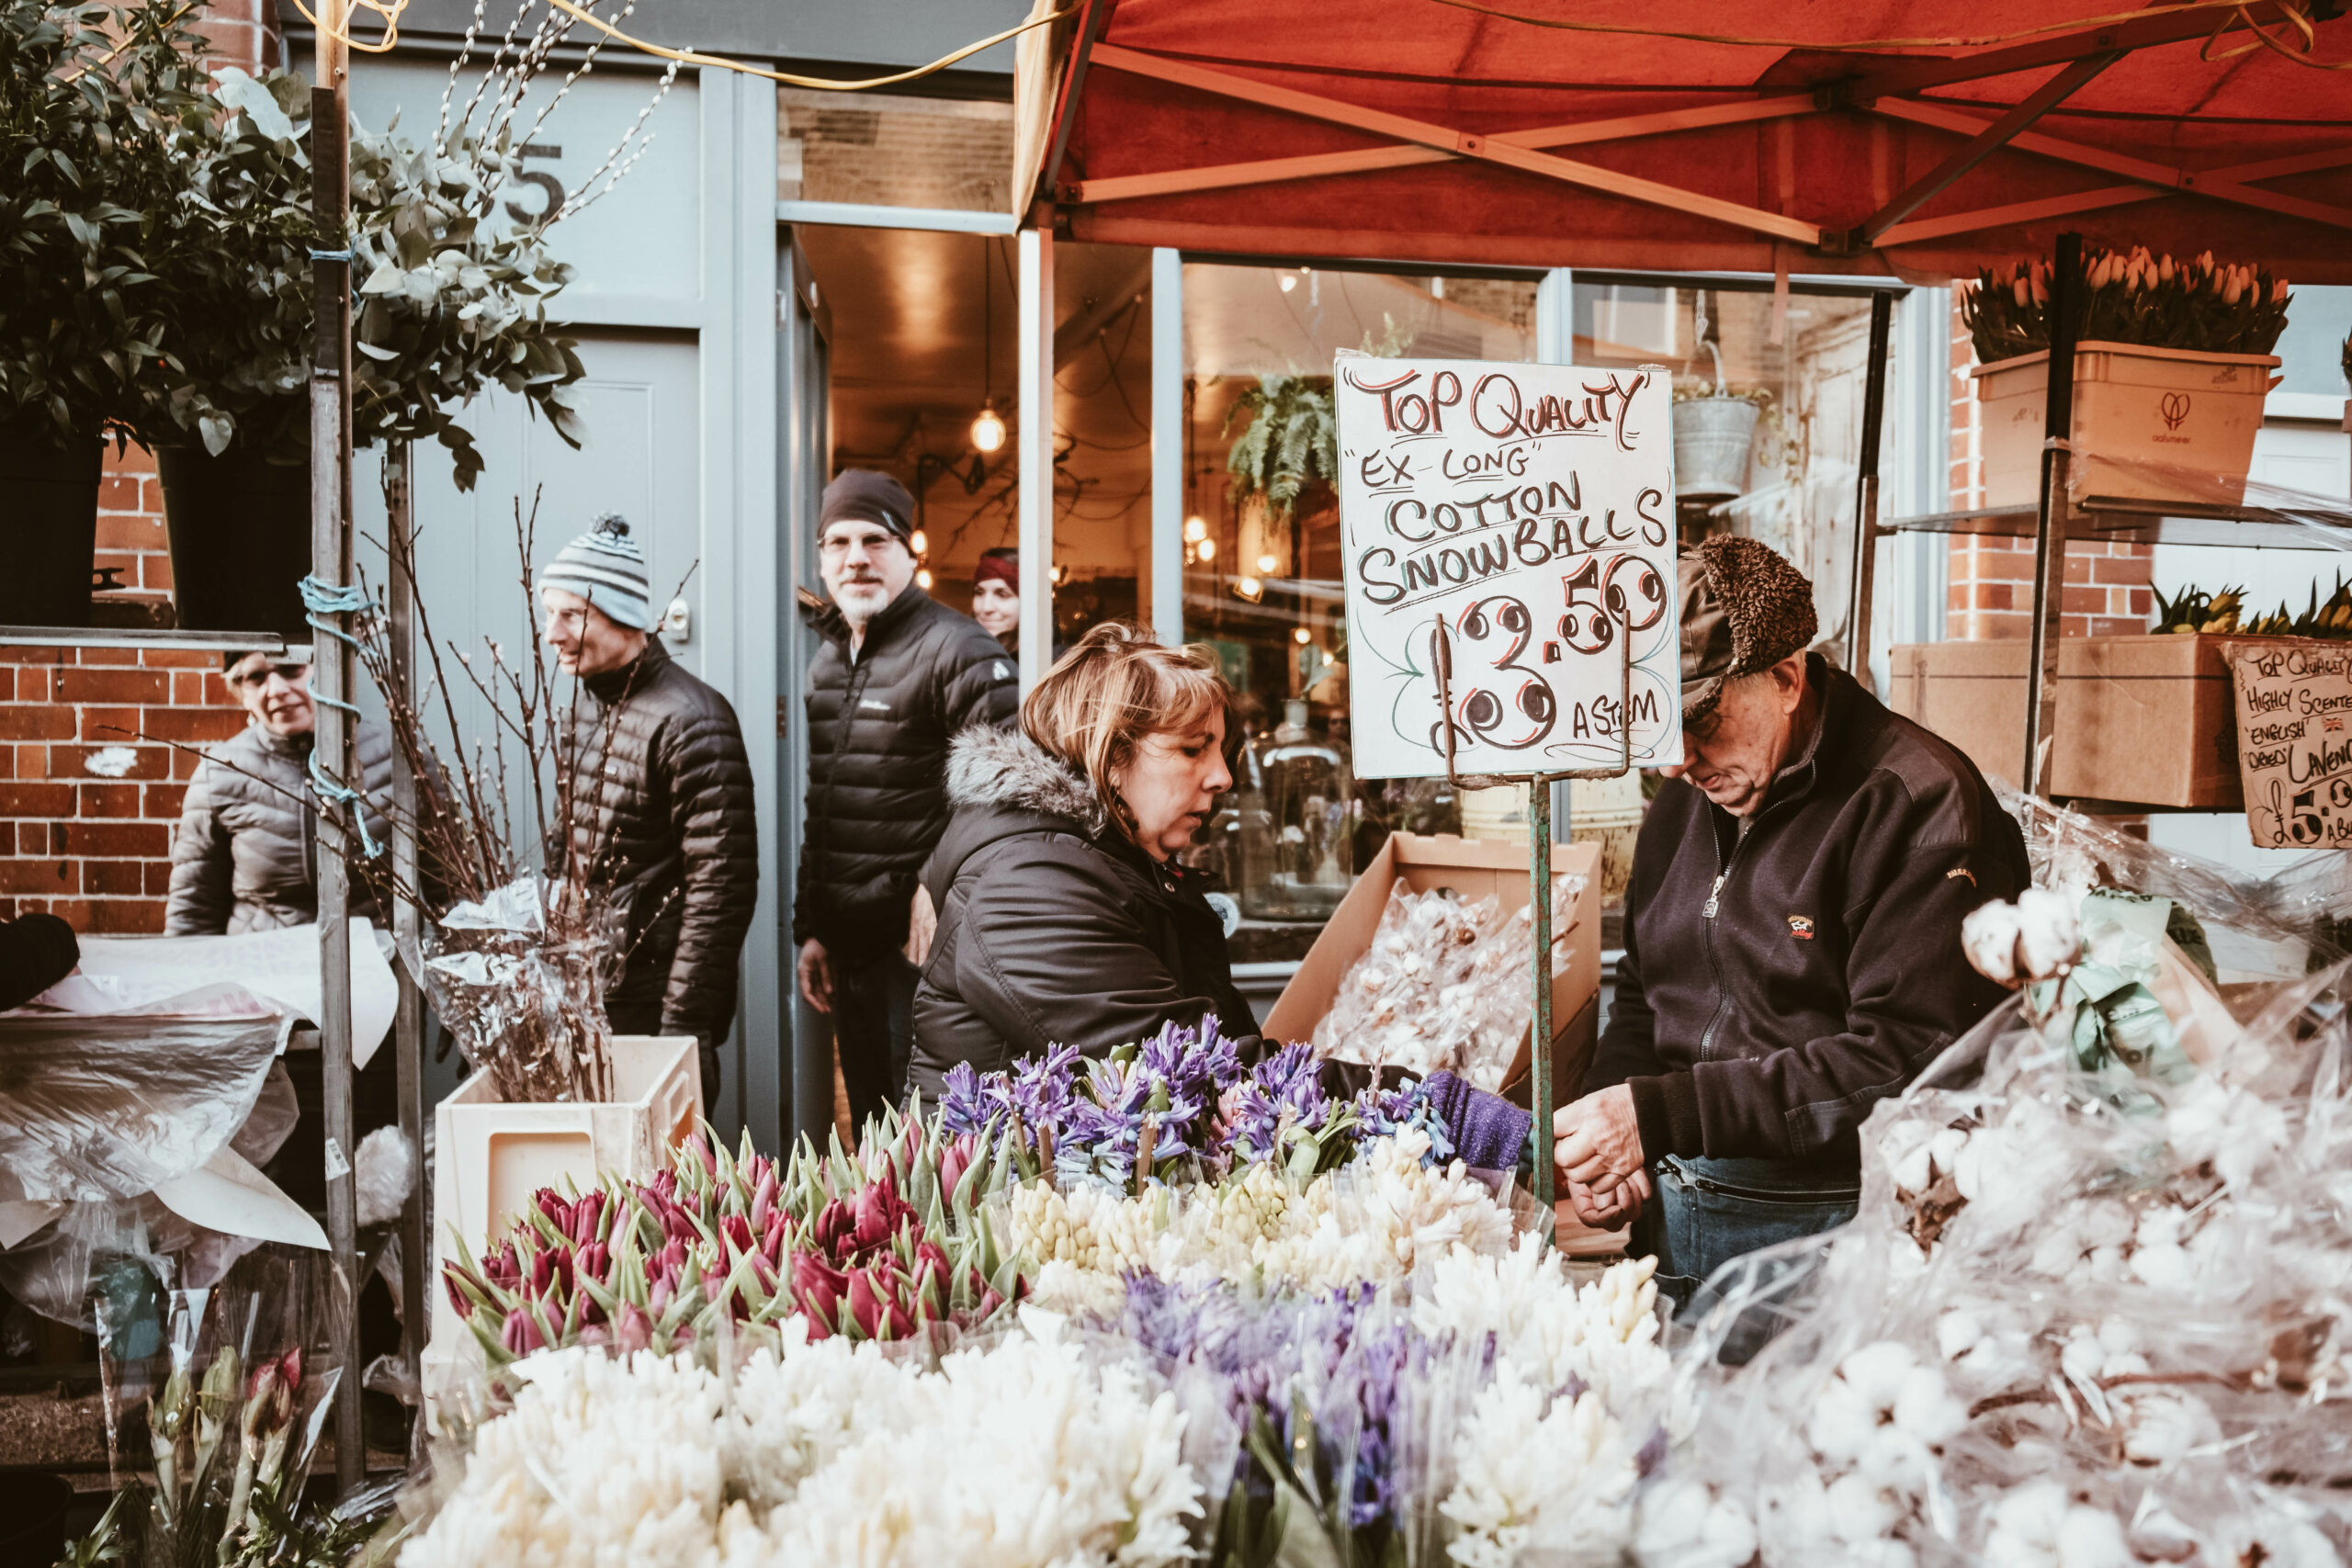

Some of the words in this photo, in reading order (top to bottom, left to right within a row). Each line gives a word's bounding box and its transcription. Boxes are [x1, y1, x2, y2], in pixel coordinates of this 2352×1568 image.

[460, 137, 567, 229] 5
[1385, 469, 1582, 543] COTTON
[1357, 489, 1667, 605] SNOWBALLS
[2245, 650, 2285, 677] TOP
[2247, 687, 2293, 713] HIGHLY
